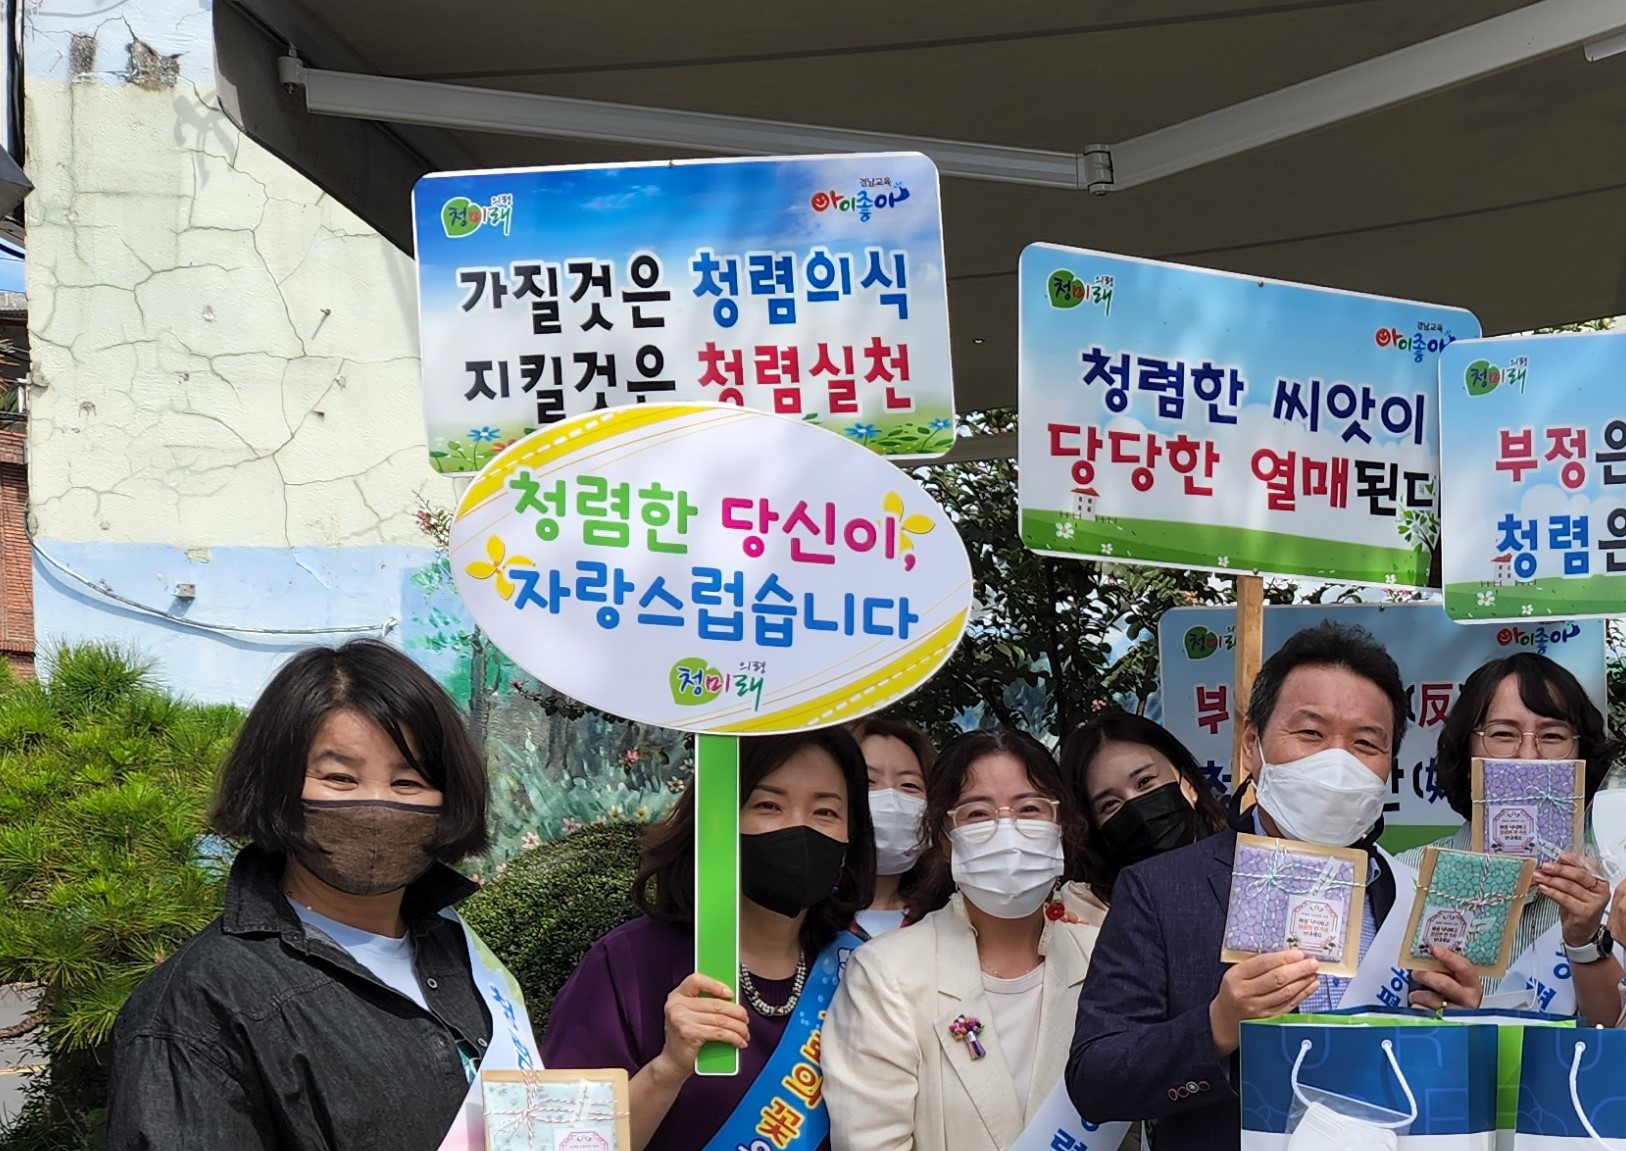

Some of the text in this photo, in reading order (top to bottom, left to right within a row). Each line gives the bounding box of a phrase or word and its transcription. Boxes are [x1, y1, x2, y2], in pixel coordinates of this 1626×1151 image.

[811, 187, 910, 222] 아이좋아
[458, 250, 911, 335] 가질것은 청렴의식
[464, 337, 912, 425] 지킬것은 청렴실천
[1081, 347, 1425, 445] 청렴한 씨앗이
[1048, 423, 1220, 497] 당당한
[509, 471, 918, 572] 청렴한 당신이,
[509, 560, 919, 647] 자랑스럽습니다
[1497, 623, 1580, 655] 아이좋아
[677, 667, 763, 711] 청미래
